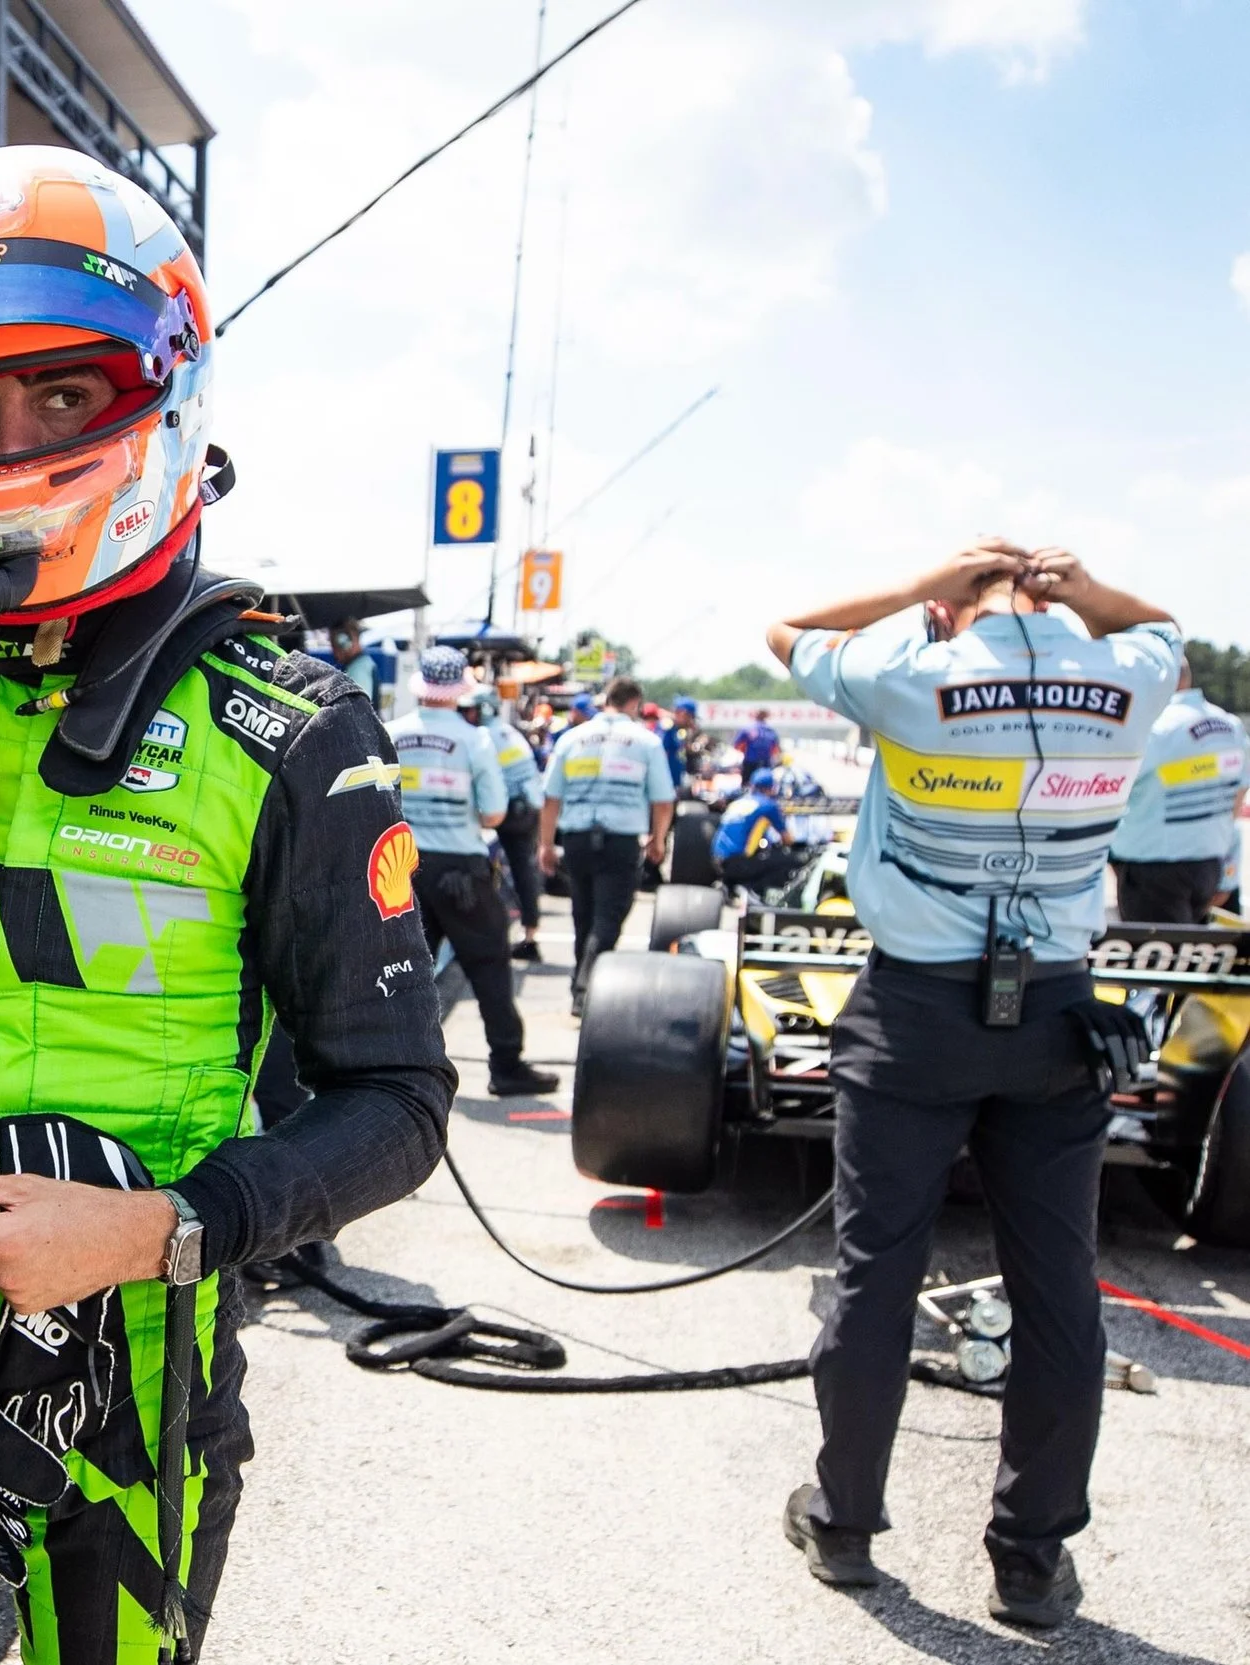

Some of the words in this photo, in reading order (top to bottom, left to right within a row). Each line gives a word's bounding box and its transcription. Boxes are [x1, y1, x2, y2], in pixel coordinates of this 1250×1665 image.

[115, 506, 150, 537] BELL
[446, 479, 484, 540] 8
[528, 570, 554, 609] 9
[951, 683, 1016, 714] JAVA
[1025, 684, 1122, 716] HOUSE
[224, 697, 286, 741] OMP
[950, 723, 995, 738] COLD
[1002, 721, 1046, 733] BREW
[1053, 722, 1115, 740] COFFEE
[134, 754, 164, 769] RIES
[137, 743, 183, 765] YCAR
[909, 766, 1003, 793] Splenda
[89, 804, 126, 821] Rinus
[128, 810, 178, 833] VeeKay
[61, 843, 196, 881] INSURANCE
[990, 855, 1026, 871] ecr
